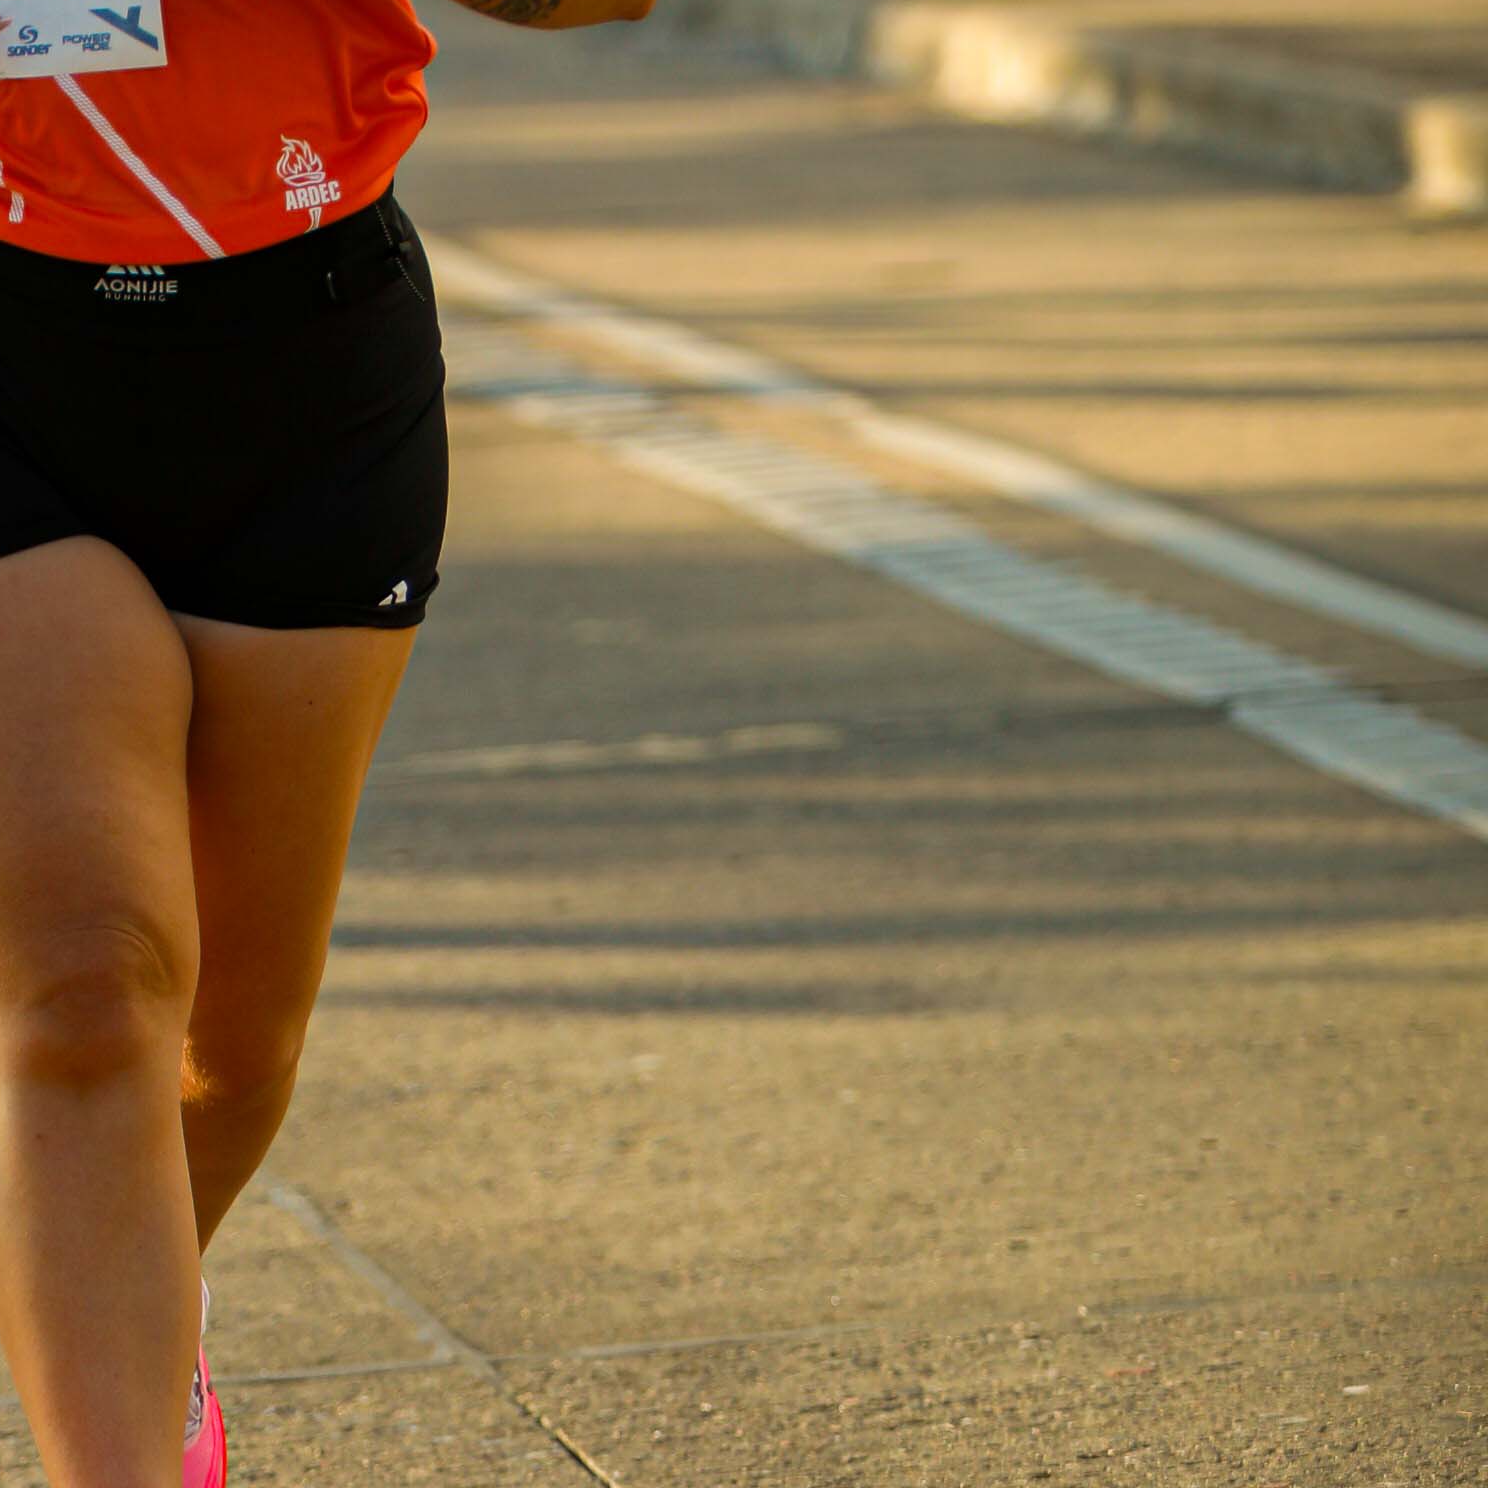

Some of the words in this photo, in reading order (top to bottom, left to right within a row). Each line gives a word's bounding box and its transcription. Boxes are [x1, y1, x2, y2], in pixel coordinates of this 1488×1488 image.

[62, 31, 111, 45] POWER
[285, 180, 341, 211] ARDEC
[94, 277, 178, 293] AONIJIE
[105, 292, 166, 302] RUNNING
